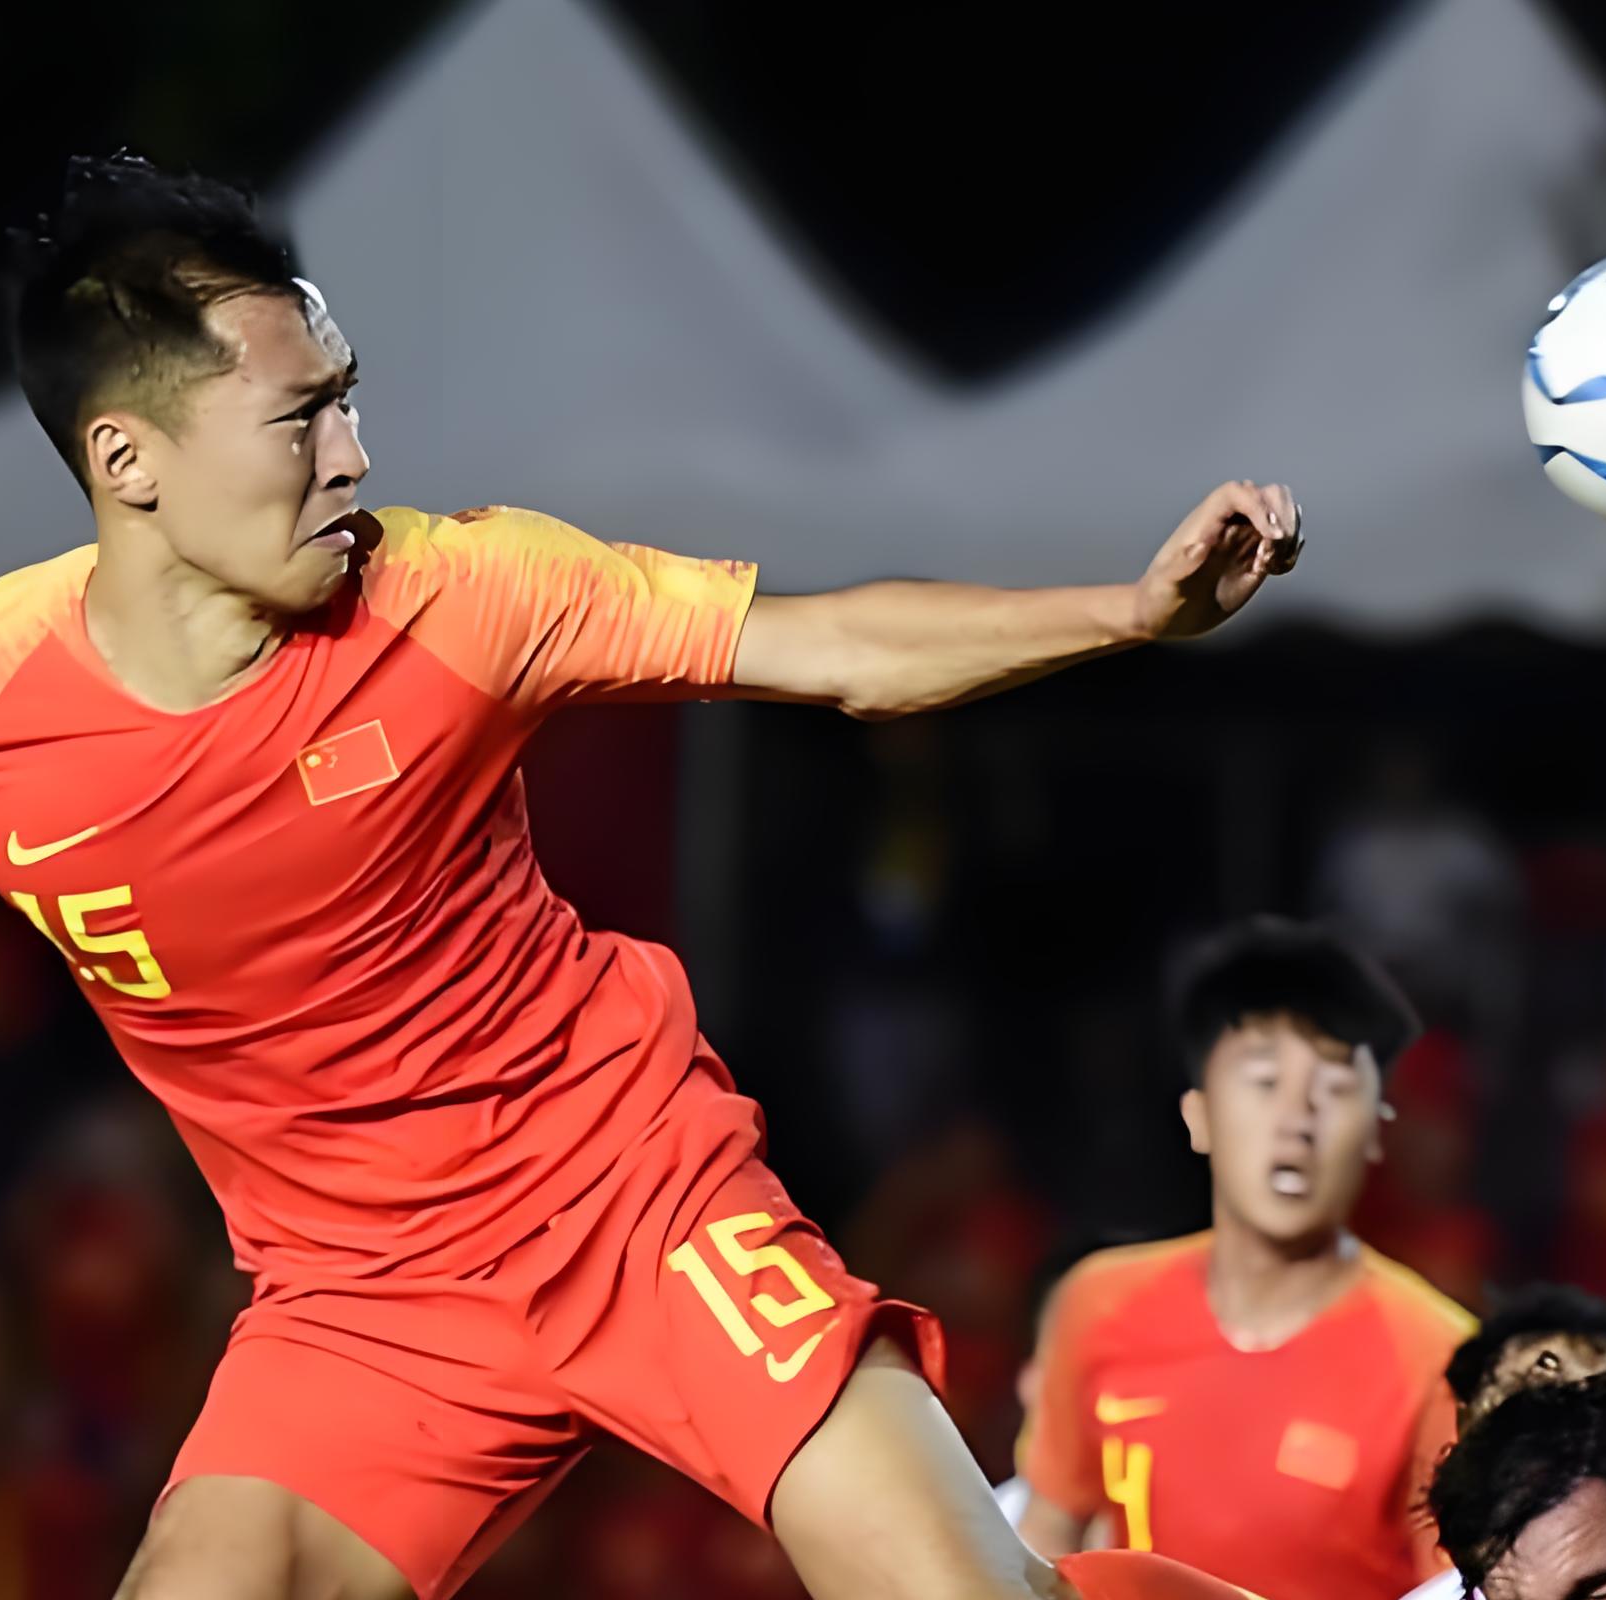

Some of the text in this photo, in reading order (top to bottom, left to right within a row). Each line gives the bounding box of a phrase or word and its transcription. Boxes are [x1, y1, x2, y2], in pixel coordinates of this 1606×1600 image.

[10, 885, 171, 999] 15
[667, 1212, 836, 1357] 15
[1101, 1434, 1153, 1552] 4
